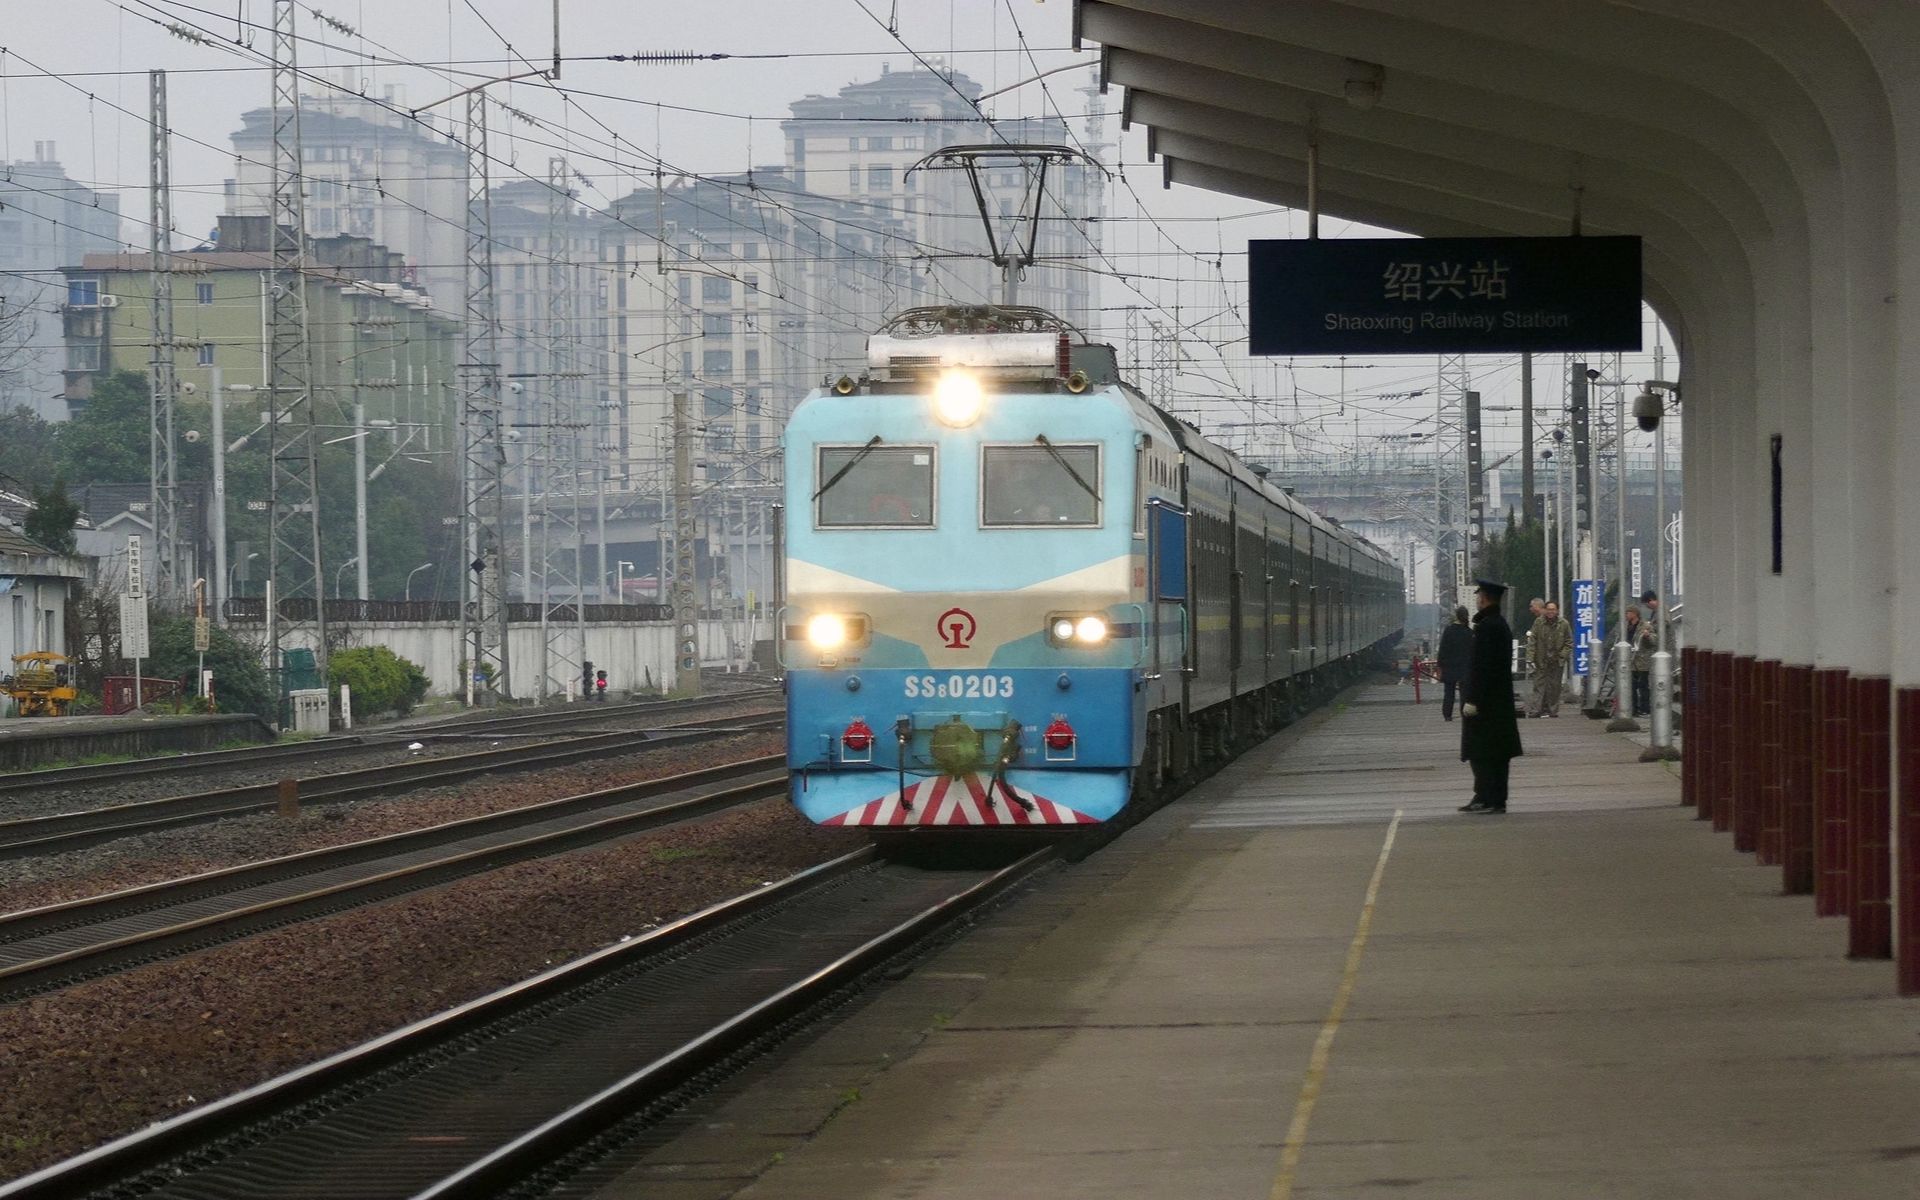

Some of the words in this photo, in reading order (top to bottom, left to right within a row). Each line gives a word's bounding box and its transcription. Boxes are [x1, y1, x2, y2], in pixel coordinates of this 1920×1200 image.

[1383, 260, 1509, 300] 绍兴站
[1324, 313, 1414, 334] Shaoxing
[1421, 311, 1496, 332] Railway
[1503, 310, 1569, 329] Station
